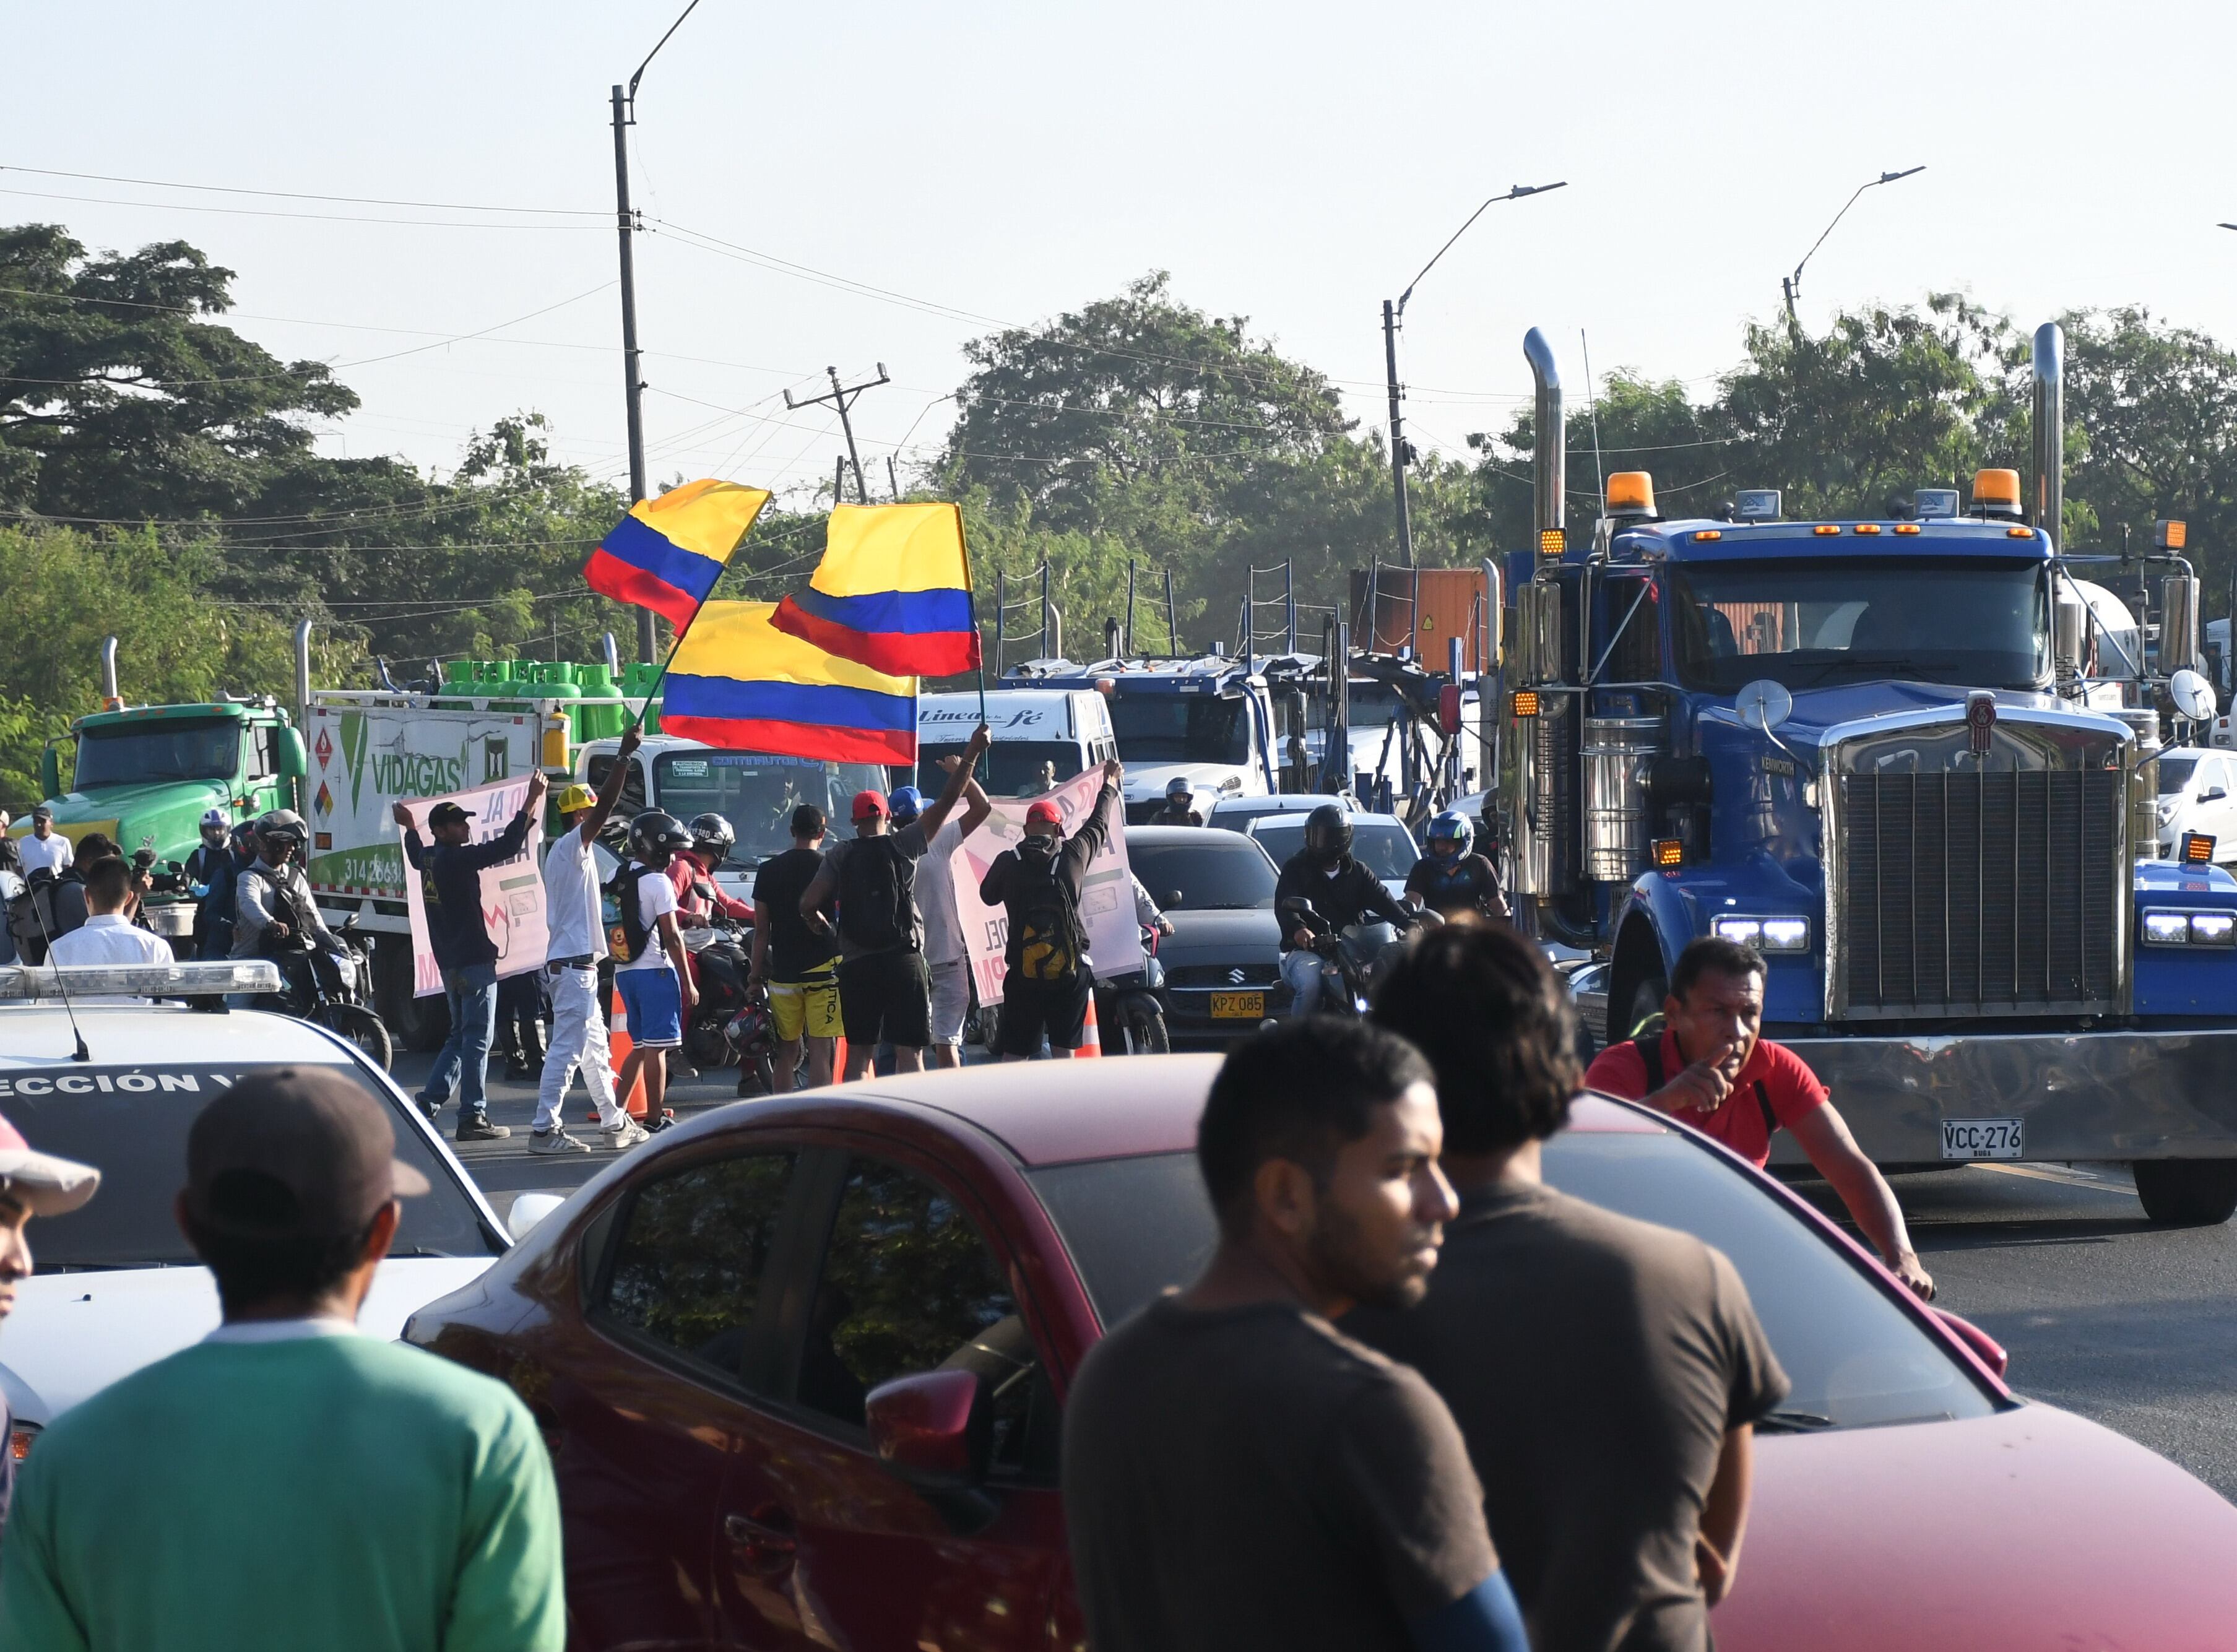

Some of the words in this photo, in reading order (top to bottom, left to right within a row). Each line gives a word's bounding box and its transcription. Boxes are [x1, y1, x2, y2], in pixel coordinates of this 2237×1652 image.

[919, 709, 982, 722] Linea
[1001, 709, 1044, 729] fé
[371, 753, 461, 797] VIDAGAS
[345, 858, 366, 881] 314
[1213, 997, 1235, 1012] KPZ
[1239, 997, 1261, 1011] 085
